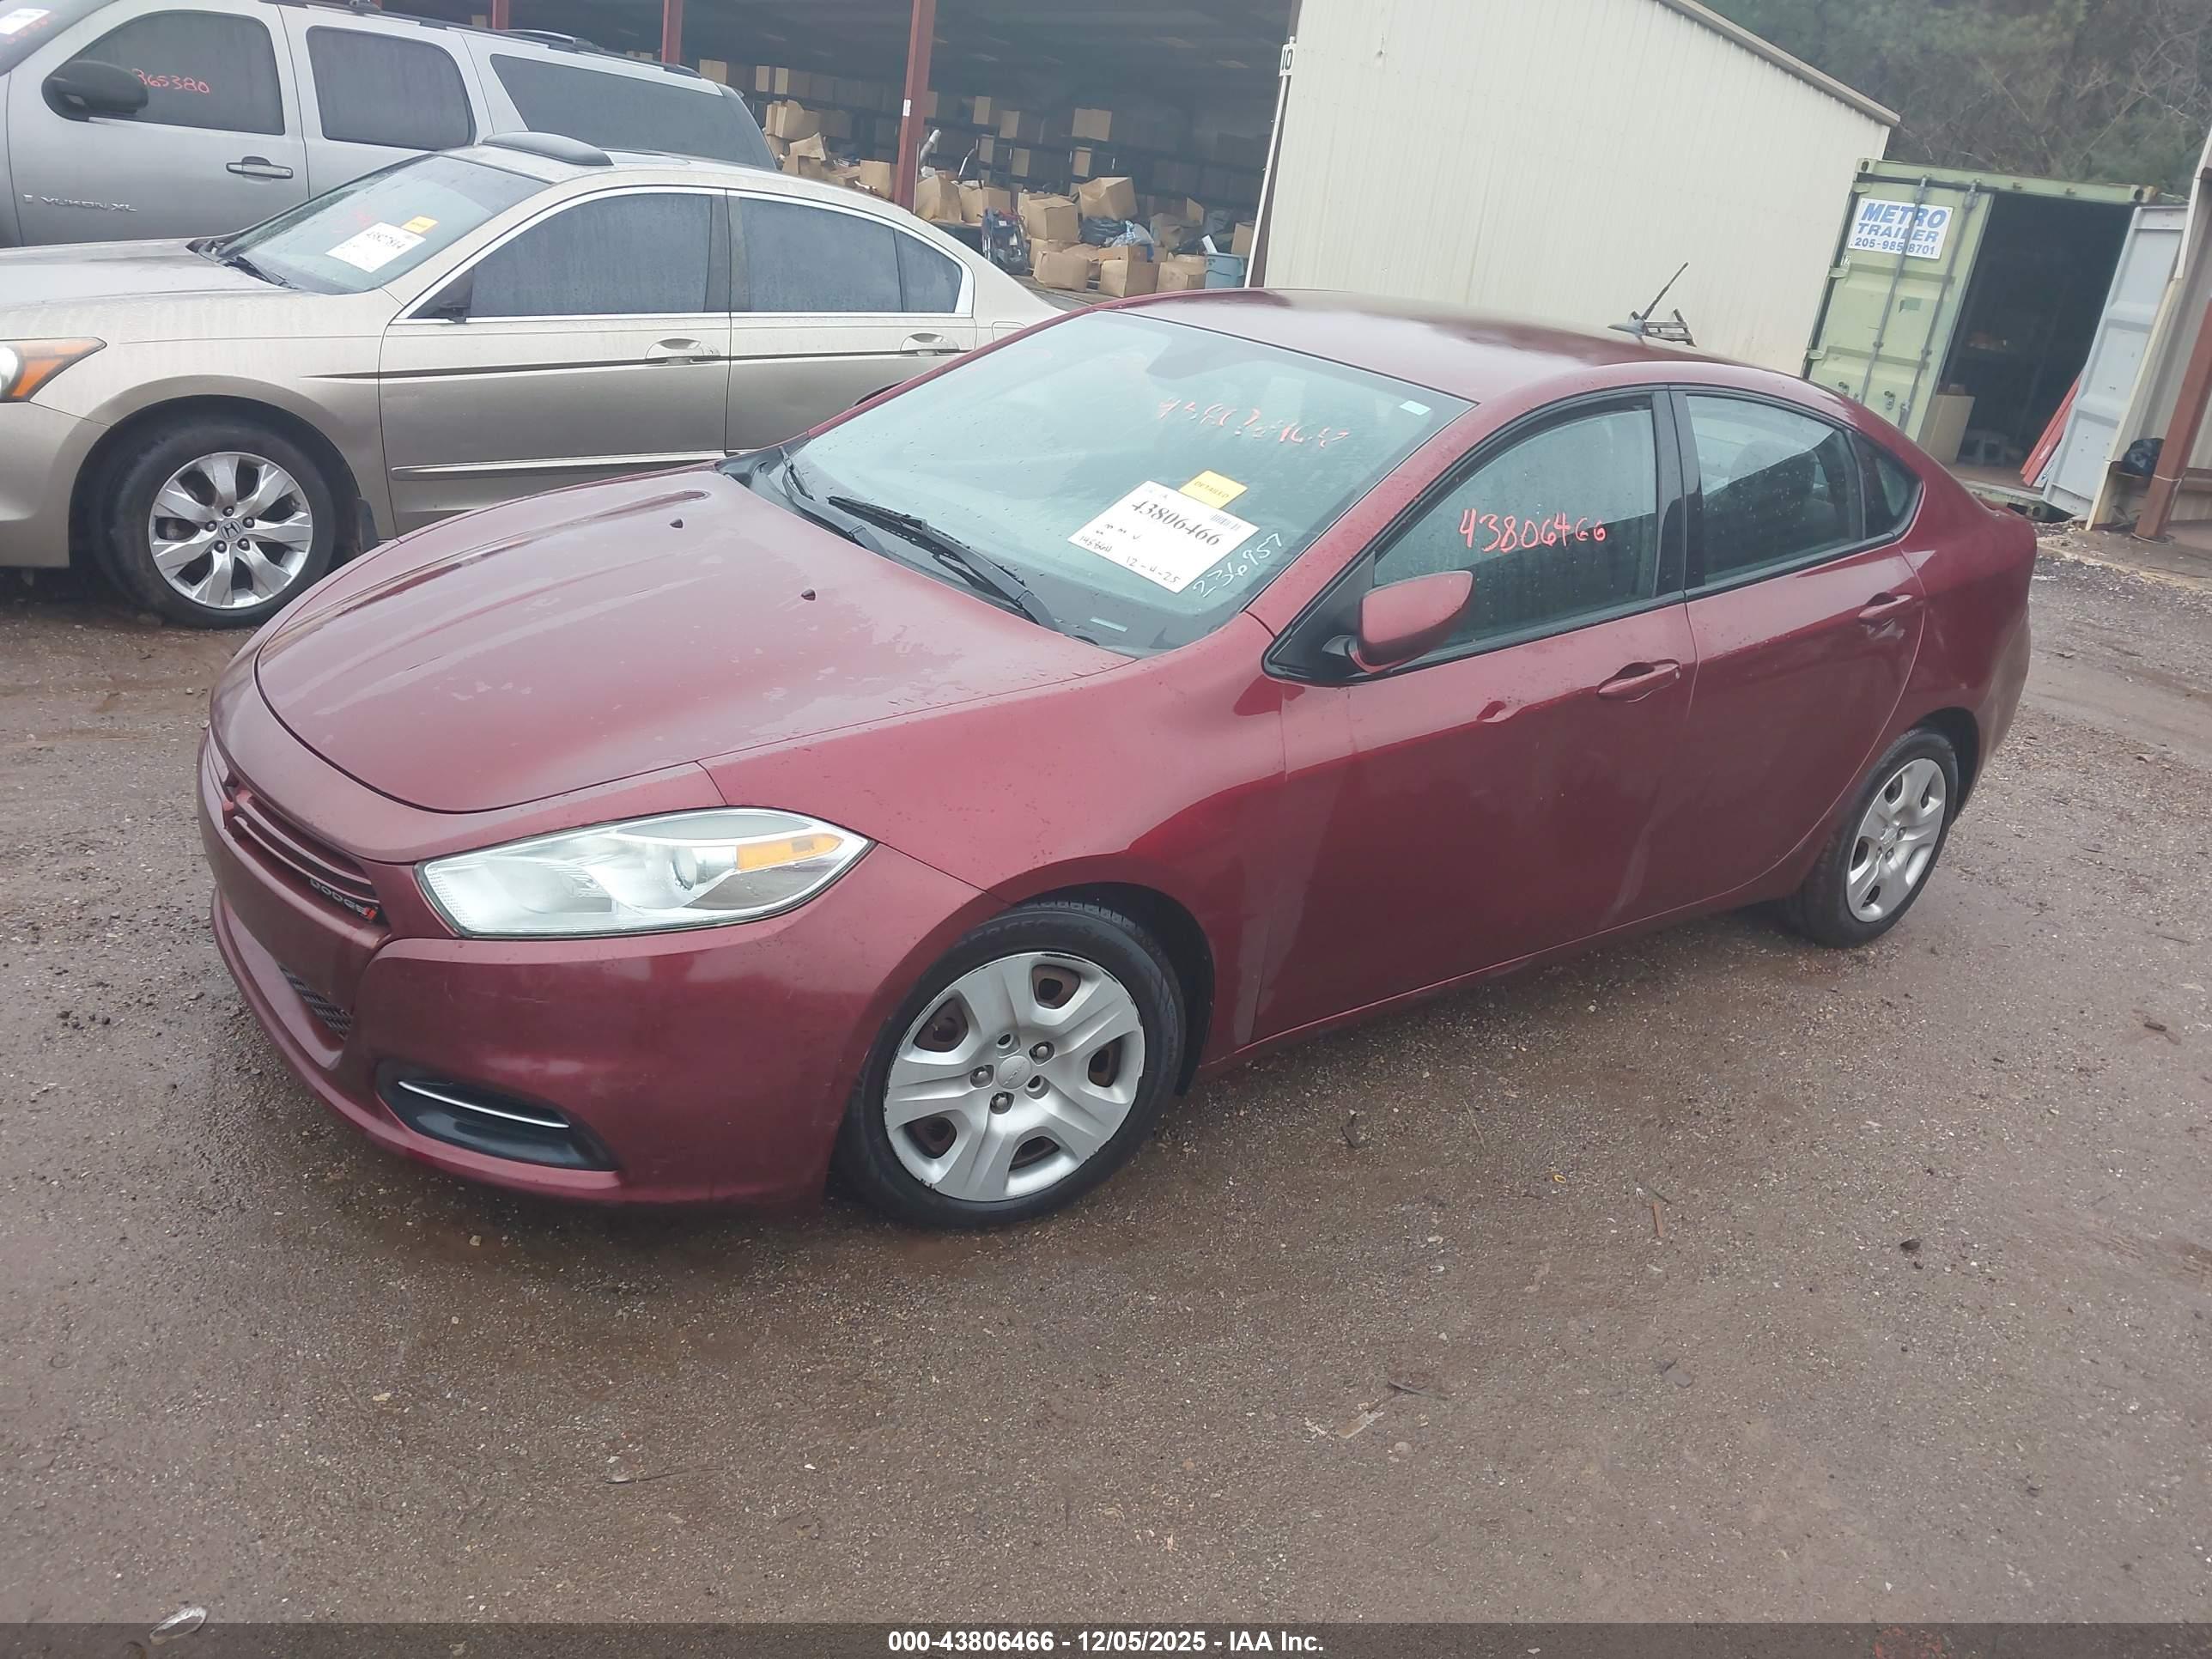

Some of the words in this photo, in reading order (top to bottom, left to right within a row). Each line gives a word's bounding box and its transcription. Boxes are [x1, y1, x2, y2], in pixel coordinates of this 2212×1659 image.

[41, 197, 108, 209] YUKON
[110, 203, 138, 212] XL
[1861, 203, 1948, 229] METRO
[1131, 500, 1224, 546] 43806466
[1459, 507, 1607, 552] 43806466
[310, 878, 368, 916] DODGE
